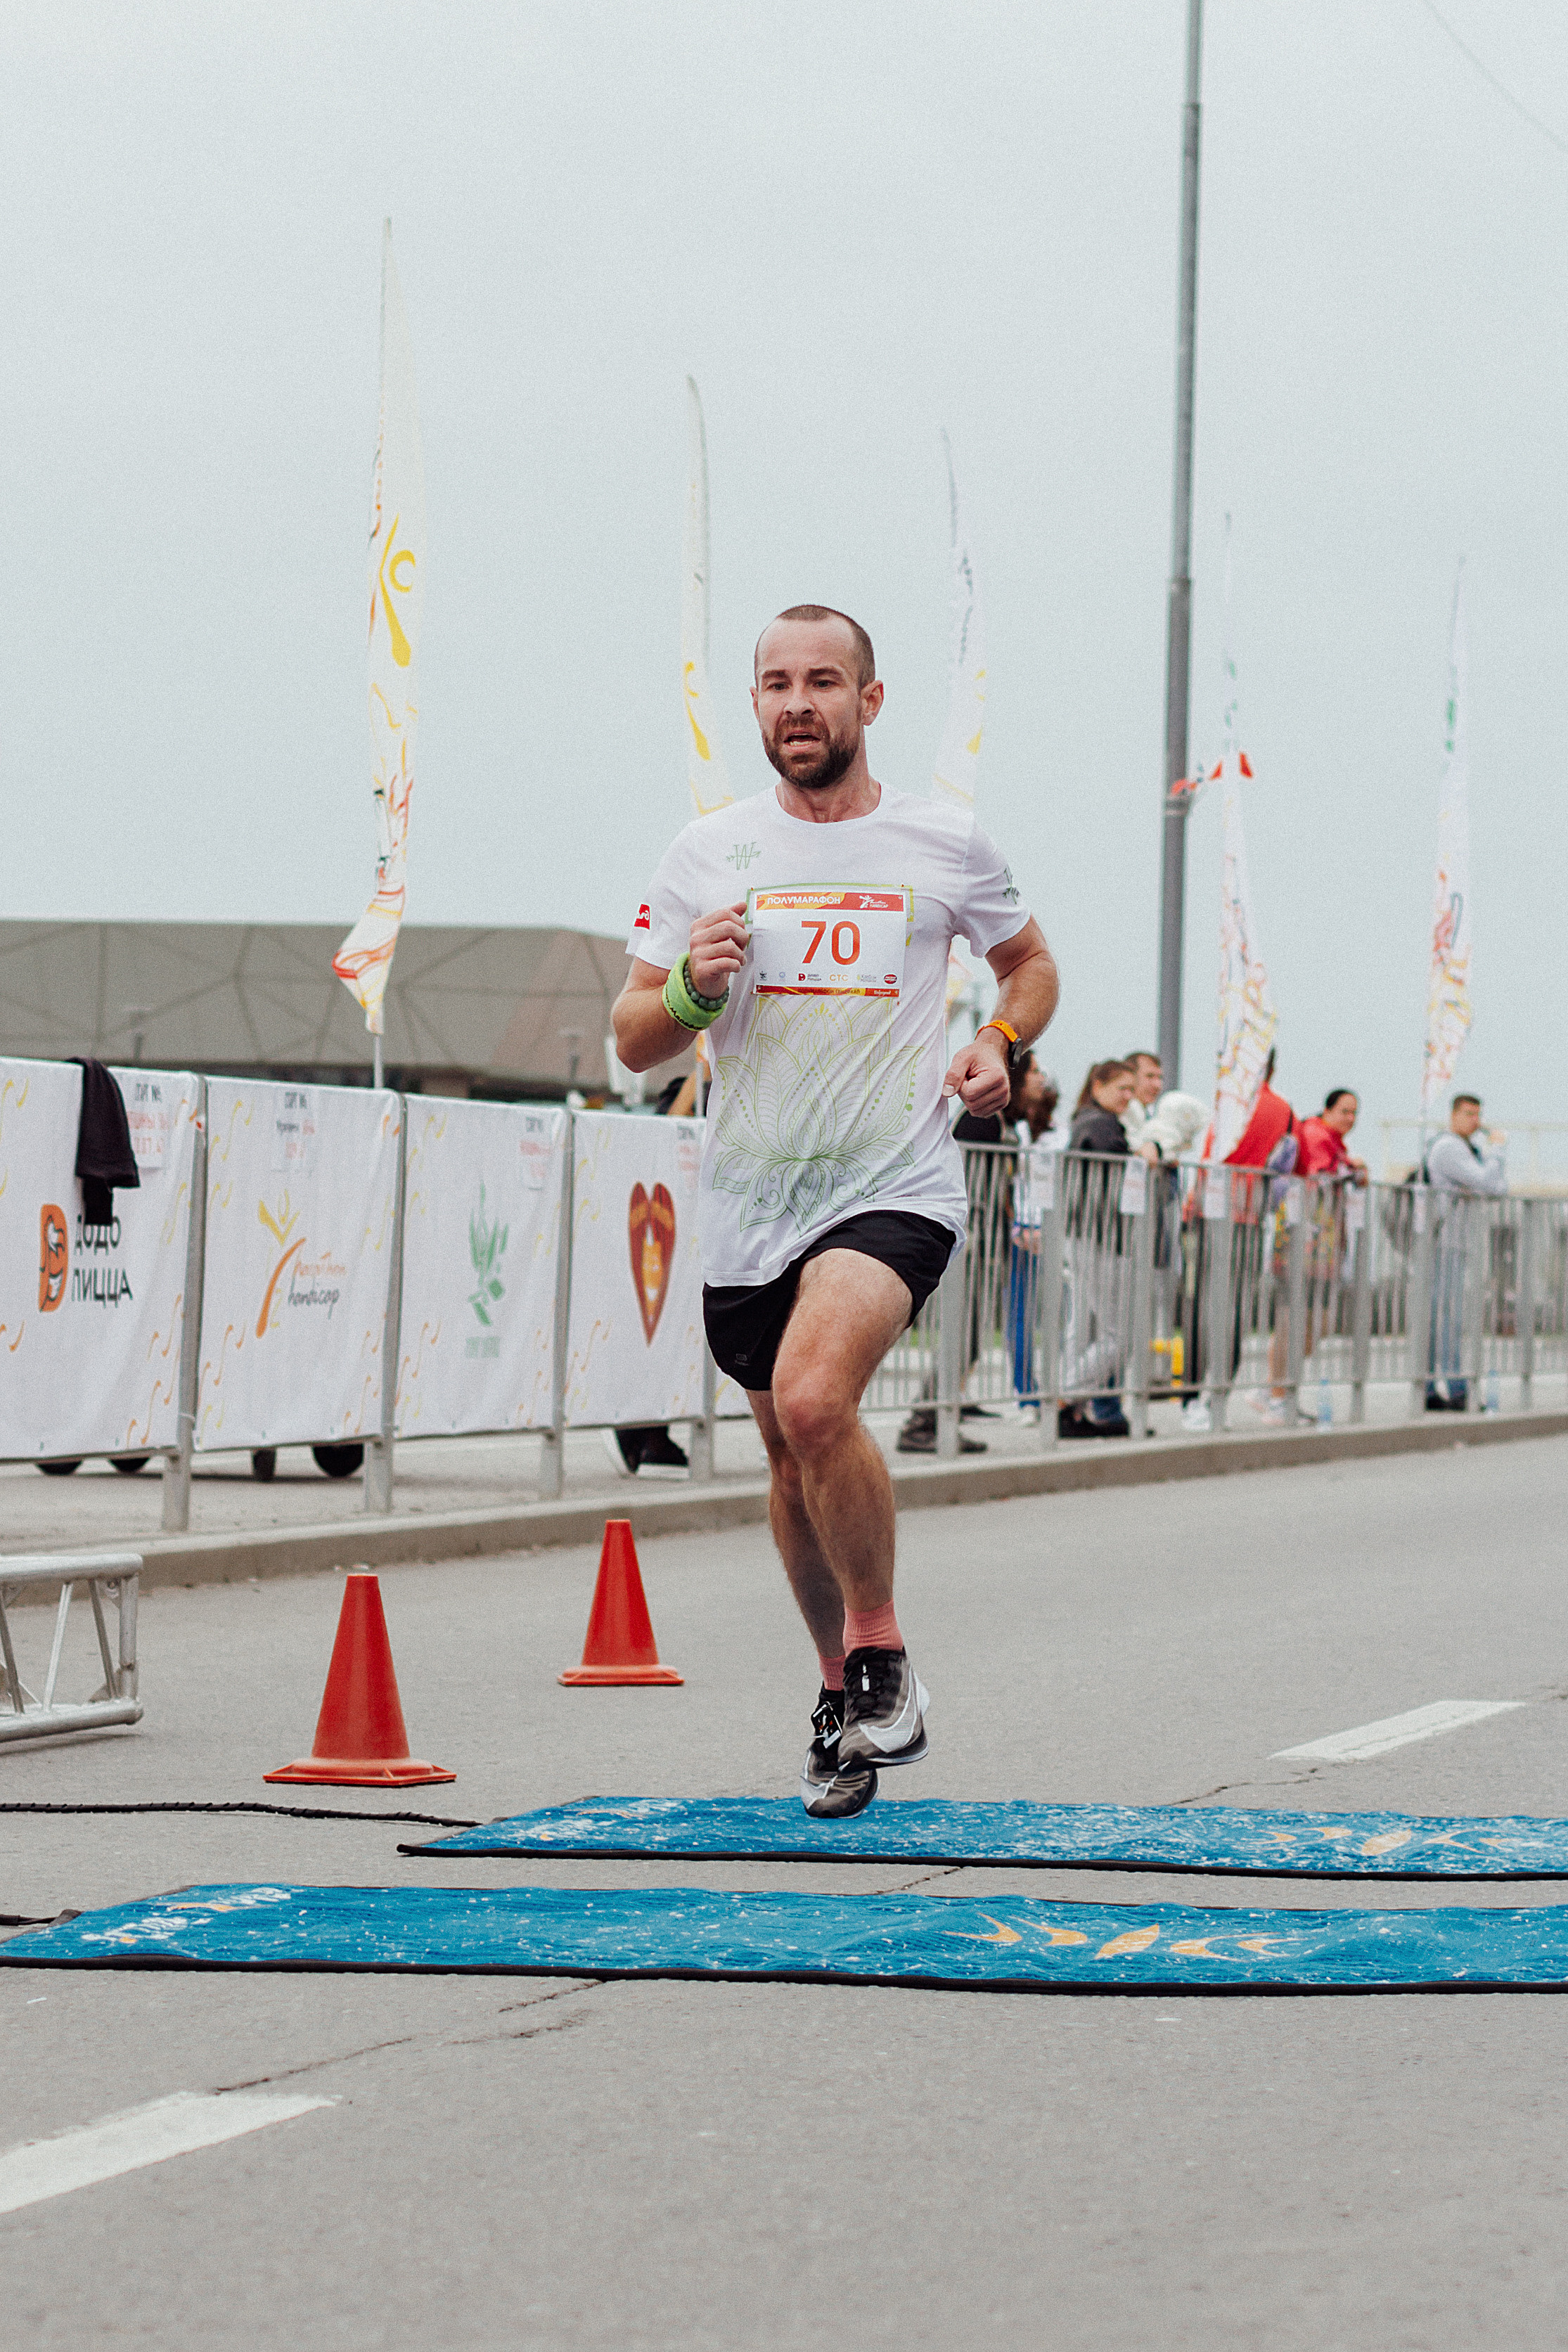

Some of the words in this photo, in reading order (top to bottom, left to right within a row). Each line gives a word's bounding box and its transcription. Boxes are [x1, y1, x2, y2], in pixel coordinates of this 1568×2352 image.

[767, 896, 841, 905] ПОЛУМАРАФОН
[801, 920, 860, 965] 70
[72, 1268, 133, 1308] ПИЦЦА
